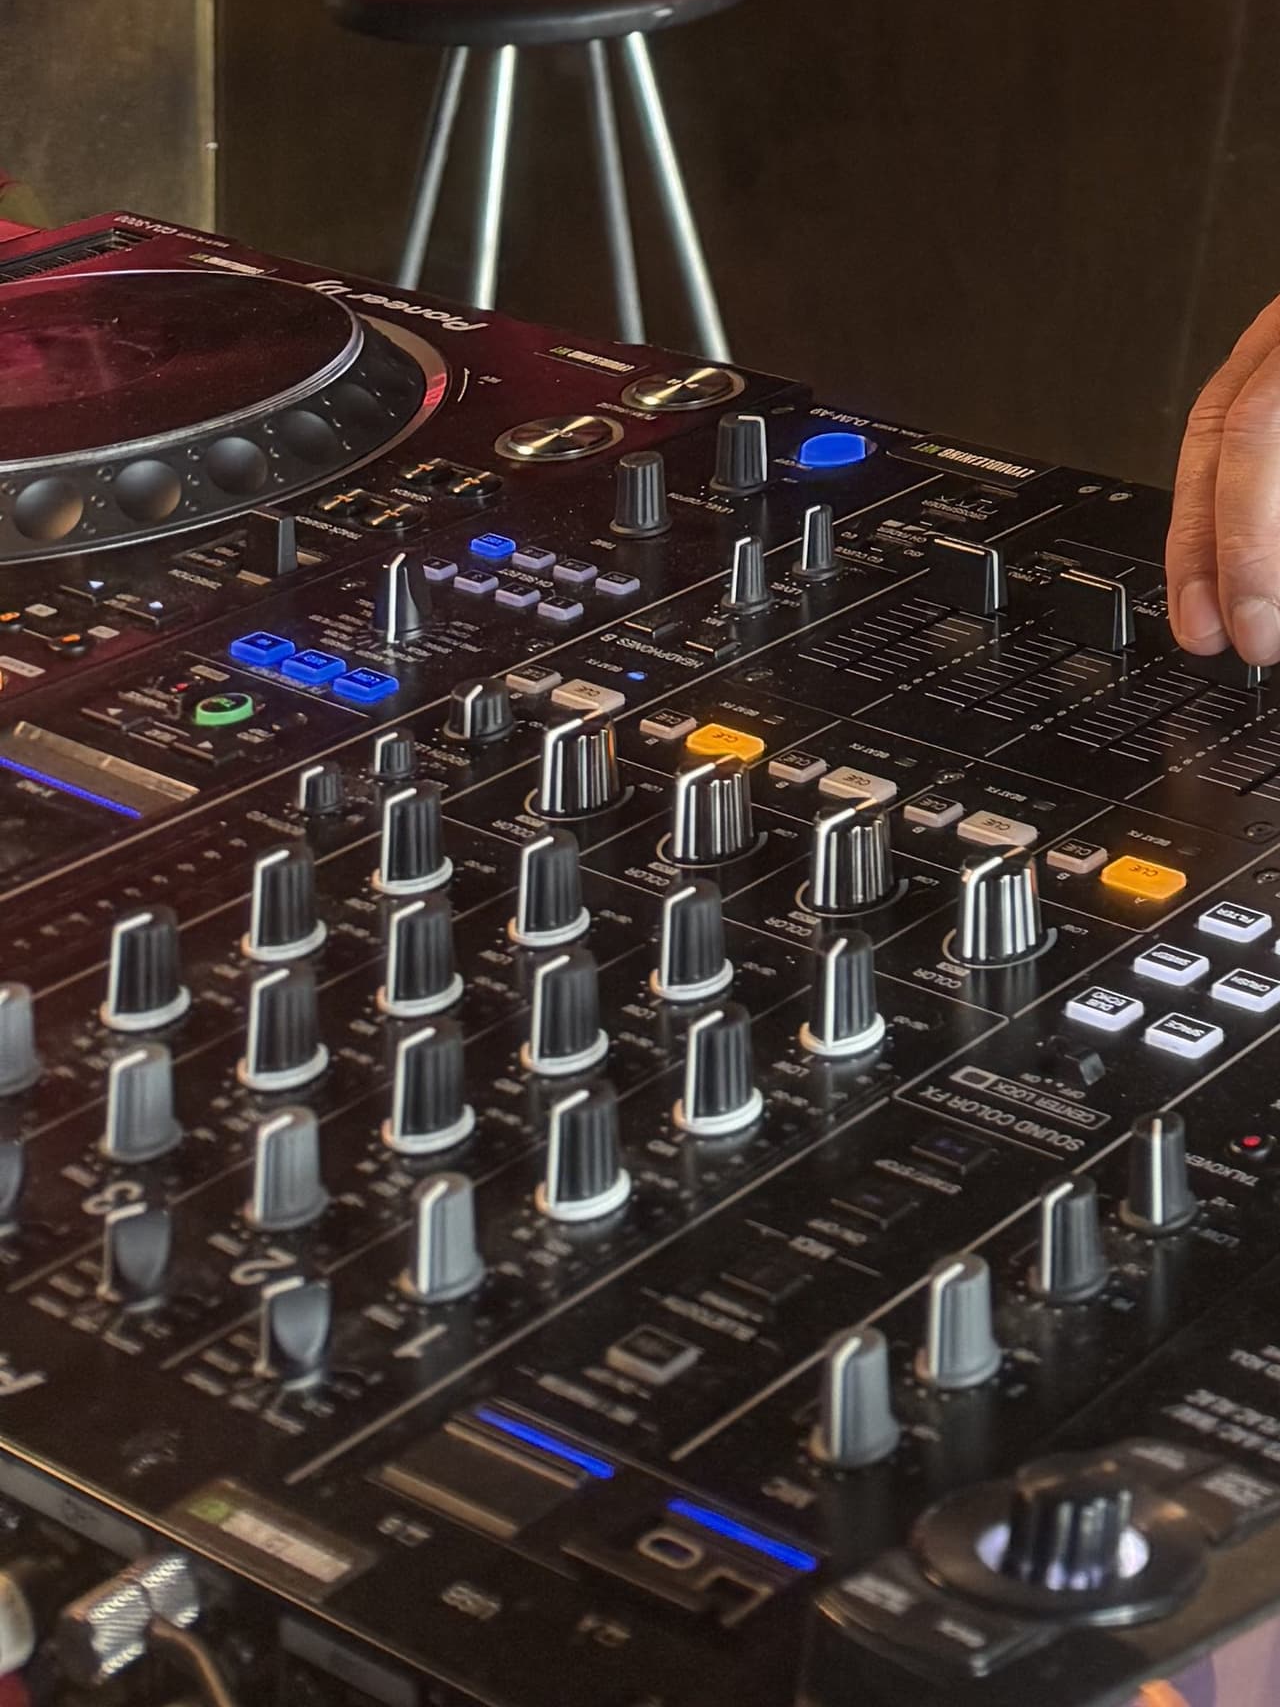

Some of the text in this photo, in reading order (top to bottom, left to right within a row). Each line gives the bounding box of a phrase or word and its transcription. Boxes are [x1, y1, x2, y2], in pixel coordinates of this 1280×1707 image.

[348, 291, 489, 332] Pioneer
[616, 639, 704, 669] HEADPHONES
[653, 711, 682, 726] CUE
[711, 730, 740, 745] CUE
[783, 754, 812, 769] CUE
[842, 771, 871, 787] CUE
[920, 797, 948, 811] CUE
[983, 816, 1012, 832] CUE
[1062, 843, 1092, 858] CUE
[1128, 864, 1158, 878] CUE
[1215, 906, 1256, 924] FILTER
[763, 914, 813, 937] COLOR
[1061, 923, 1089, 937] LOW
[1150, 950, 1193, 967] SWEEP
[913, 966, 963, 988] COLOR
[1229, 975, 1272, 993] CRUSH
[1085, 998, 1114, 1012] DUB
[1090, 991, 1127, 1007] ECHO
[1164, 1020, 1205, 1038] SPACE
[993, 1081, 1098, 1124] CENTER LOCK
[917, 1086, 1086, 1152] SOUND COLOR FX
[228, 1247, 298, 1287] 2
